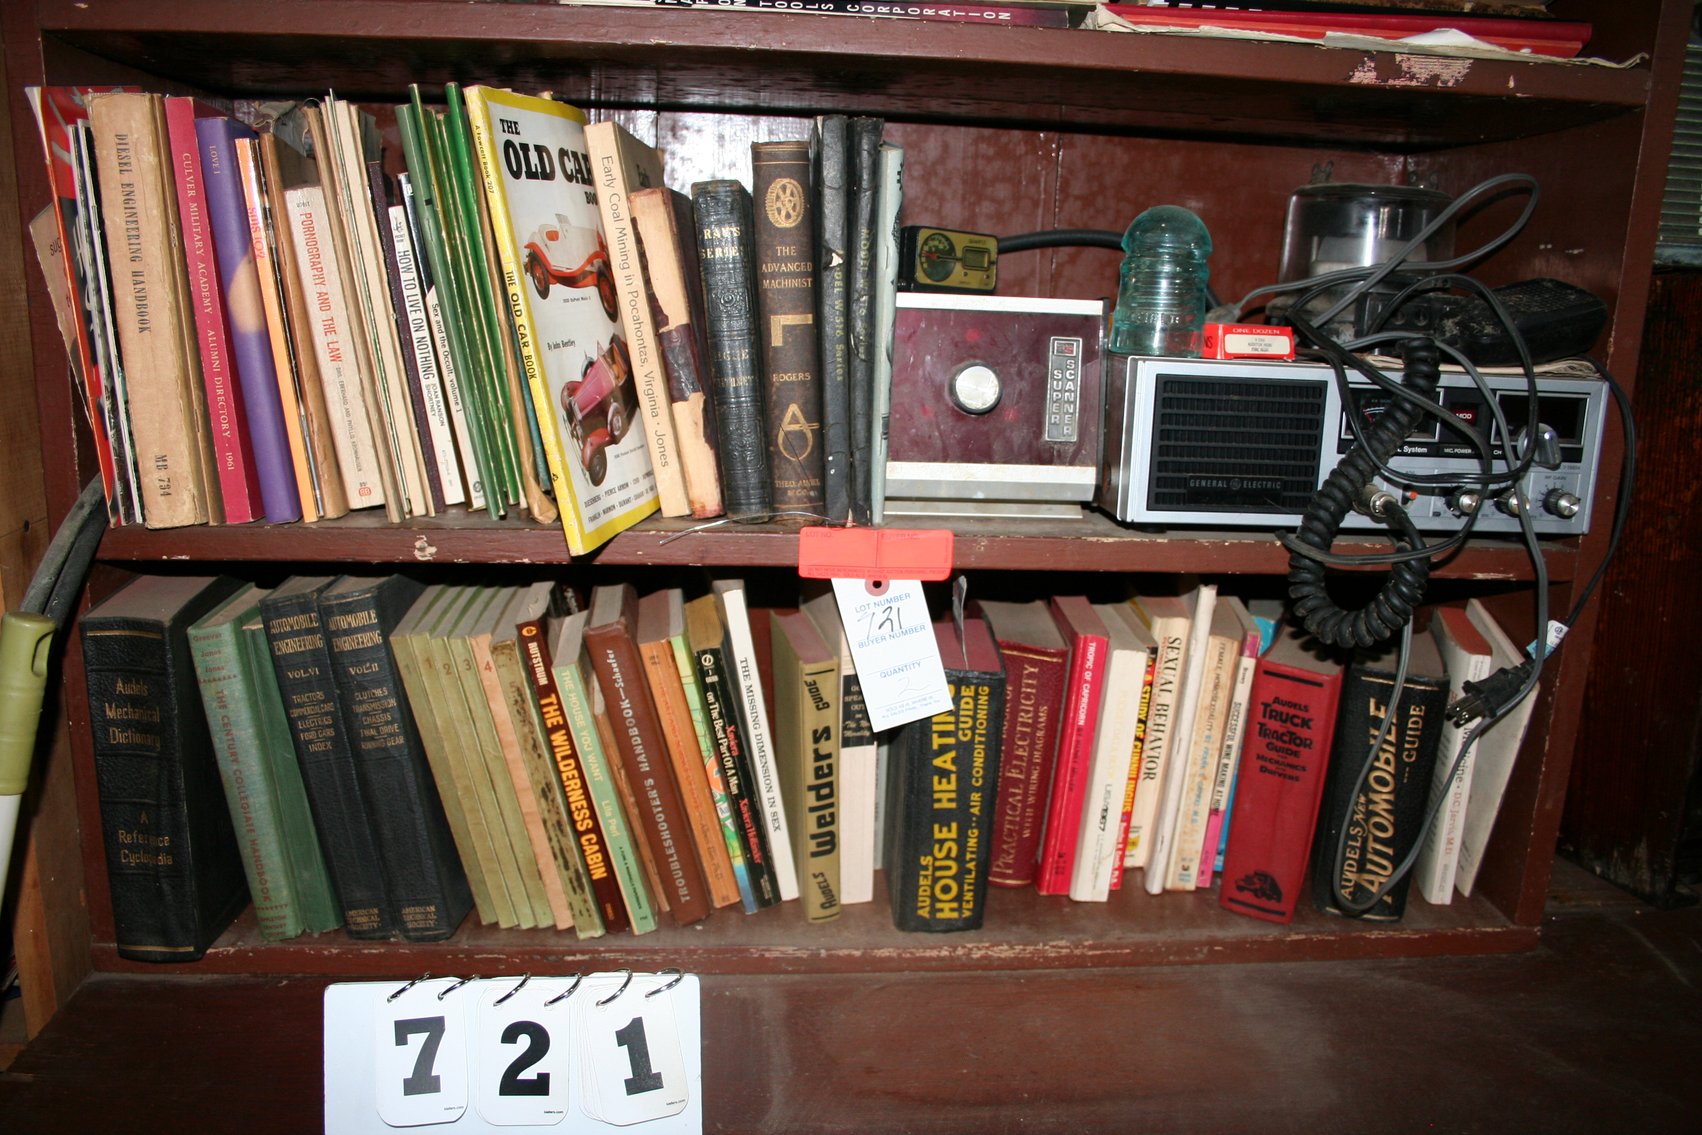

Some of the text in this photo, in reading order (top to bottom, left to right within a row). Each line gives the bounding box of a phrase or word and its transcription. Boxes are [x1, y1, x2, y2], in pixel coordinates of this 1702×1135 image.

[760, 0, 1011, 20] TOOLS CORPORATION
[499, 118, 520, 135] THE
[483, 161, 491, 179] Book
[503, 139, 556, 181] OLD
[486, 180, 495, 194] 207
[115, 133, 151, 333] DIESEL ENGINEERING HANDBOOK
[299, 212, 328, 287] PORNOGRAPHY
[776, 246, 798, 257] THE
[398, 250, 414, 274] HOW
[761, 262, 813, 273] ADVANCED
[402, 277, 417, 291] TO
[762, 277, 814, 289] MACHINIST
[182, 152, 235, 471] CULVER MILITARY ACADEMY ALUMNI DIRECTORY 1961
[316, 290, 332, 312] AND
[407, 294, 422, 317] LIVE
[432, 303, 441, 318] Sex
[602, 155, 670, 467] Early Coal Mining in Pocahontas, Virginia Jones
[321, 317, 337, 337] THE
[411, 319, 426, 334] ON
[435, 319, 445, 334] and
[506, 270, 537, 380] THE OLD CAR BOOK
[325, 342, 343, 363] LAW
[438, 335, 447, 349] the
[415, 336, 436, 380] NOTHING
[772, 372, 811, 382] ROGERS
[431, 382, 440, 401] JOAN
[449, 378, 460, 407] volume
[1051, 359, 1076, 436] SUPER SCANNER
[1403, 445, 1428, 455] System
[1190, 479, 1281, 489] GENERAL ELECTRIC
[855, 592, 911, 614] LOT NUMBER
[269, 612, 319, 635] AUTOMOBILE
[328, 608, 378, 632] AUTOMOBILE
[273, 633, 324, 656] ENGINEERING
[331, 630, 383, 653] ENGINEERING
[858, 624, 927, 649] BUYER NUMBER
[443, 663, 453, 676] 2
[463, 658, 472, 672] 3
[484, 660, 493, 673] 4
[528, 642, 549, 687] RUTSTRUM
[880, 661, 921, 680] QUANTITY
[1159, 636, 1183, 695] SEXUAL
[115, 677, 149, 696] Audels
[1077, 641, 1097, 726] TROPIC OF CAPRICORN
[215, 689, 228, 711] THE
[706, 691, 716, 705] on
[1271, 696, 1309, 713] AUDELS
[105, 702, 161, 723] Mechanical
[709, 703, 720, 720] The
[958, 684, 976, 742] GUIDE
[1134, 685, 1152, 739] STUDY OF
[1226, 701, 1242, 745] SUCCESSFUL
[1260, 701, 1314, 730] TRUCK
[561, 670, 605, 783] THE HOUSE YOU WANT
[714, 719, 725, 740] Best
[1257, 721, 1314, 750] TRACTOR
[1402, 704, 1426, 763] GUIDE
[109, 726, 161, 751] Dictionary
[221, 715, 241, 764] CENTURY
[718, 737, 729, 759] Part
[725, 724, 740, 757] Xaviera
[740, 657, 782, 833] THE MISSING DIMENSION IN SEX
[1143, 703, 1170, 782] BEHAVIOR
[1265, 741, 1302, 759] GUIDE
[723, 757, 733, 769] Of
[1222, 743, 1233, 761] WINE
[1256, 753, 1307, 772] MECHANICS
[726, 767, 735, 777] A
[991, 663, 1040, 874] PRACTICAL ELECTRICITY
[1022, 705, 1049, 839] WITH WIRING DIAGRAMS
[1217, 762, 1230, 789] MAKING
[1259, 765, 1301, 782] DRIVERS
[540, 693, 609, 881] THE WILDERNESS CABIN
[728, 775, 740, 796] Man
[804, 679, 838, 911] AUDELS Welders GUIDE
[234, 768, 256, 834] COLLEGIATE
[961, 685, 990, 918] VENTILATING AIR CONDITIONING
[1355, 697, 1398, 905] AUTOMOBILE
[644, 778, 692, 904] TROUBLESHOOTER'S
[249, 838, 272, 902] HANDBOOK
[933, 821, 960, 920] HOUSE
[1341, 827, 1363, 901] AUDELS
[917, 855, 934, 919] AUDELS
[394, 1015, 665, 1097] 7 2 1
